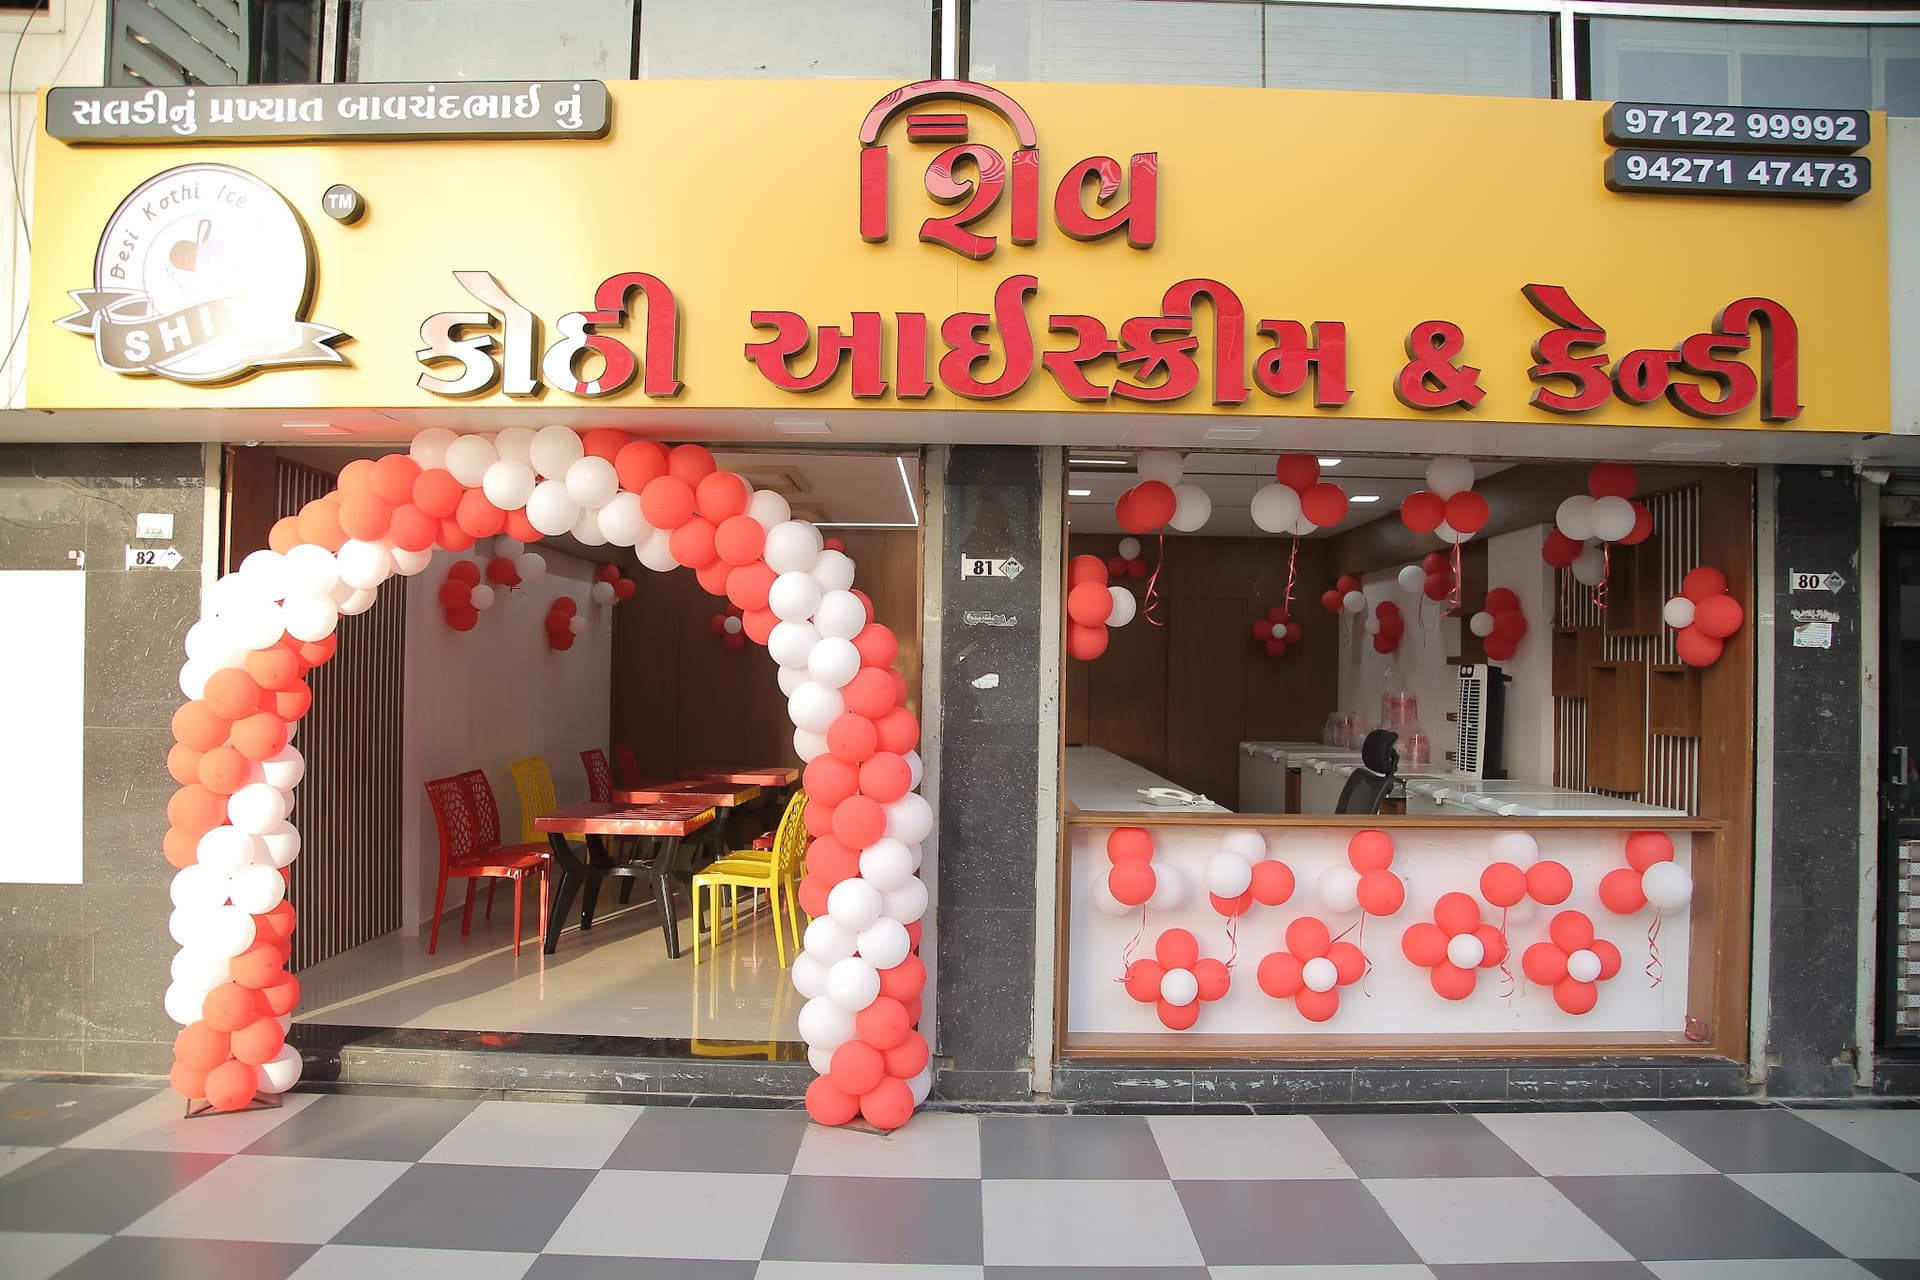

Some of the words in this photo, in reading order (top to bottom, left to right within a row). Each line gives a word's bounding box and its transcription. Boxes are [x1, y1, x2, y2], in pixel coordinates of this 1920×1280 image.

[72, 89, 198, 135] સલડીનું
[208, 97, 324, 123] પ્રખ્યાત
[337, 83, 541, 121] બાવચંદભાઈ
[1624, 108, 1735, 137] 97122
[1746, 113, 1857, 141] 99992
[859, 79, 1158, 260] શિવ
[1626, 155, 1732, 184] 94271
[1747, 160, 1858, 188] 47473
[327, 193, 353, 209] TM
[110, 229, 139, 280] Desi
[142, 182, 200, 221] Kothi
[217, 185, 248, 208] Ice
[124, 305, 214, 362] SHI
[416, 270, 685, 398] કોઠી
[744, 274, 1353, 407] આઈસ્ક્રીમ
[1393, 320, 1487, 411] &
[1521, 282, 1805, 423] કેન્ડી
[135, 550, 155, 565] 82
[973, 560, 993, 576] 81
[1798, 574, 1820, 589] 80
